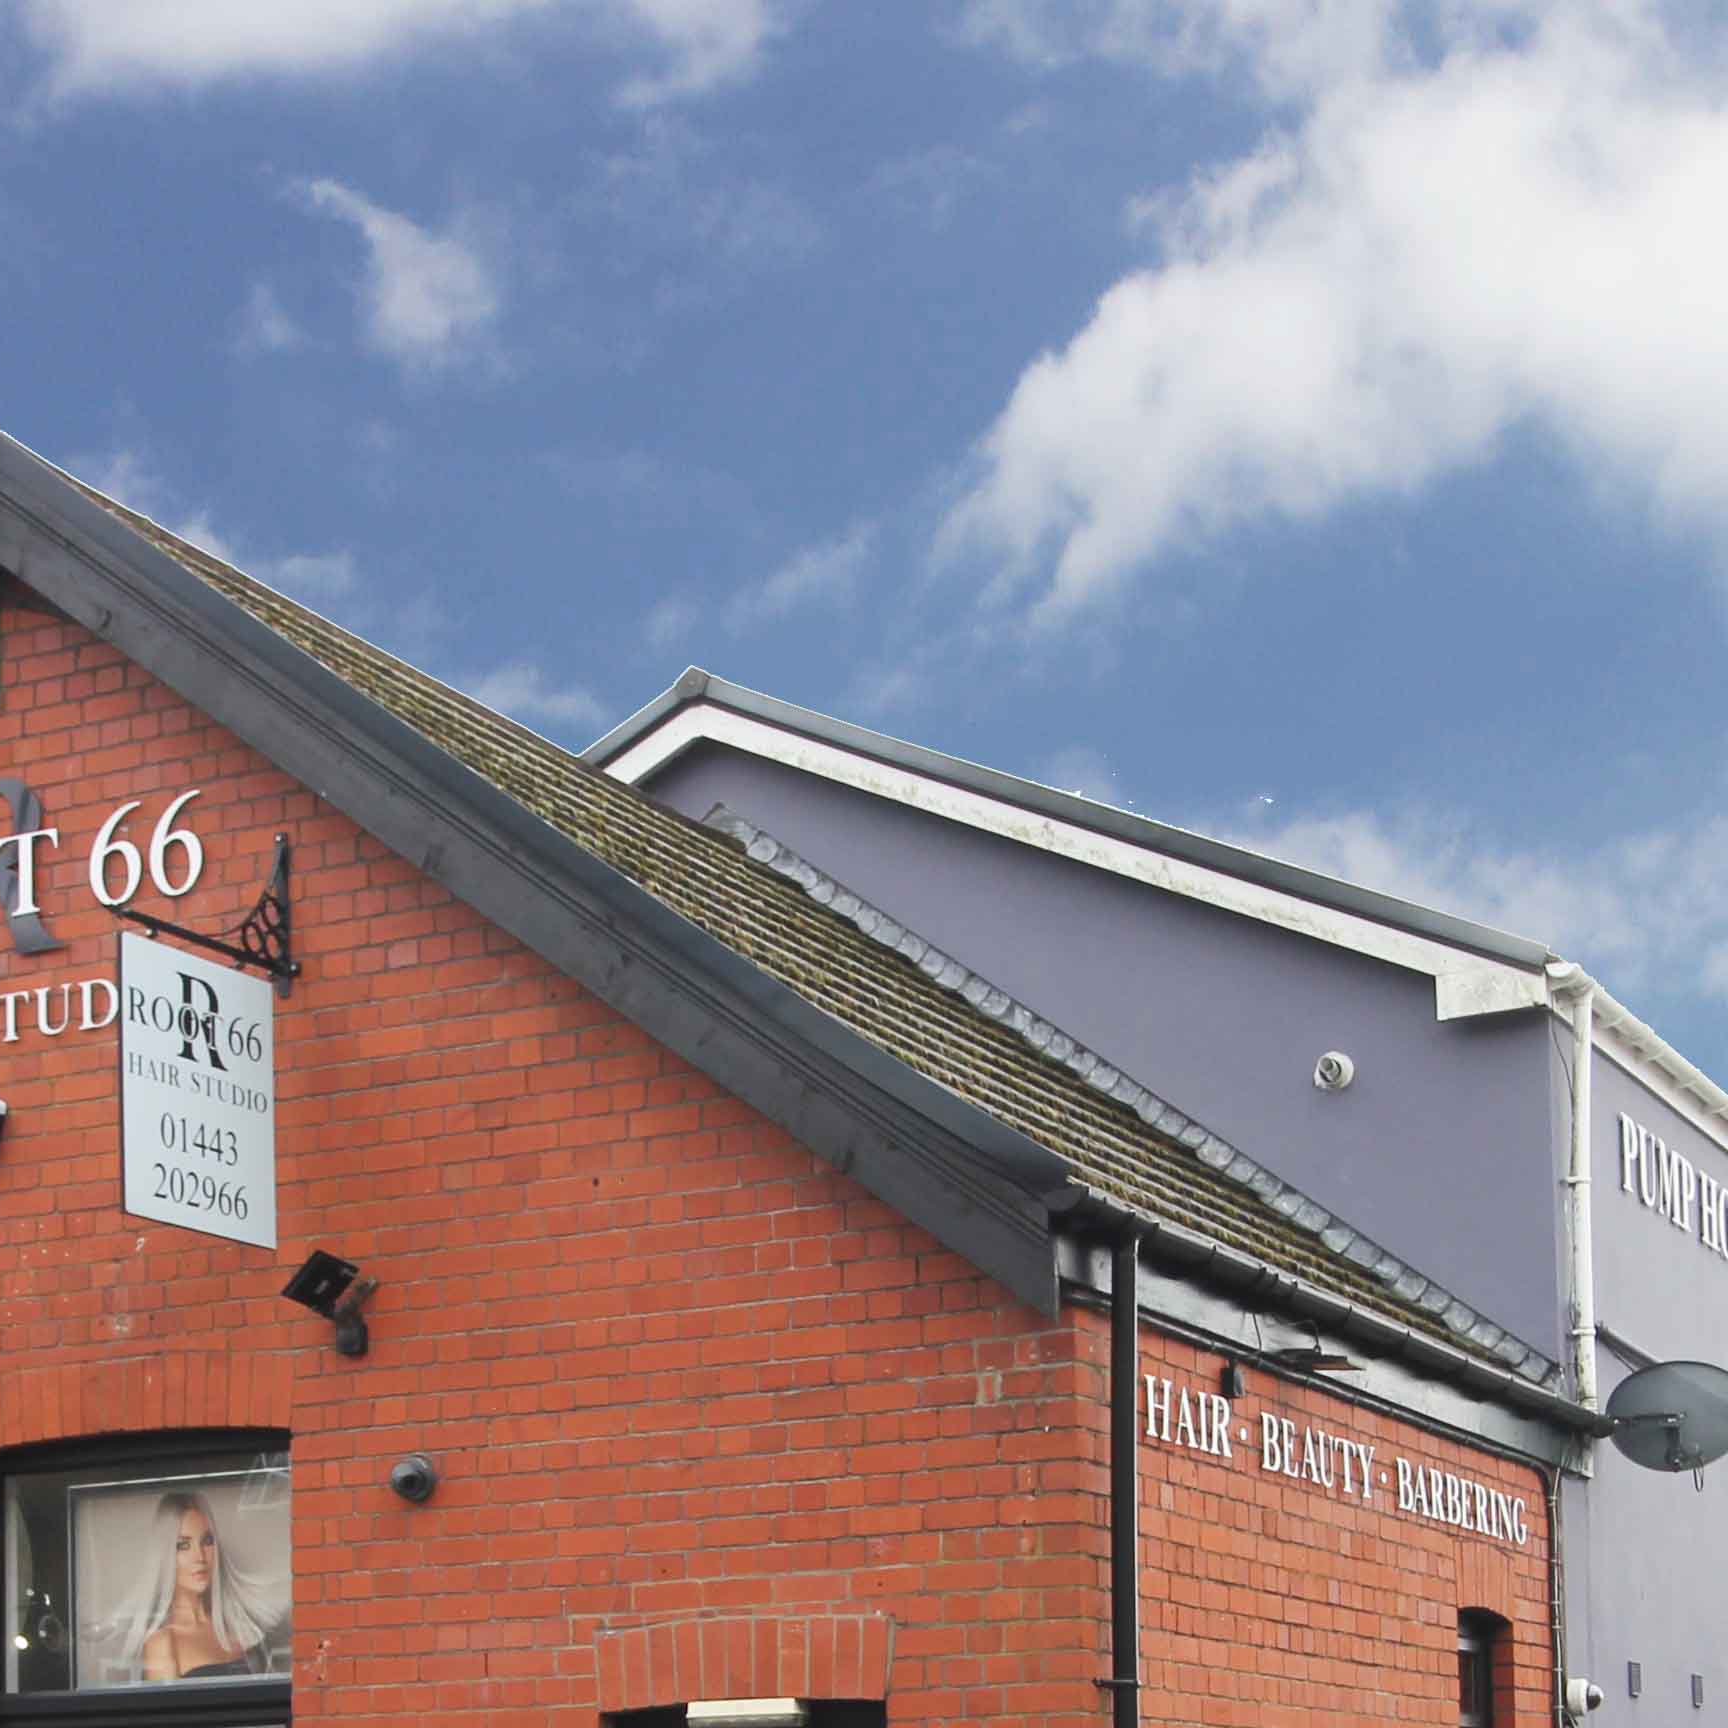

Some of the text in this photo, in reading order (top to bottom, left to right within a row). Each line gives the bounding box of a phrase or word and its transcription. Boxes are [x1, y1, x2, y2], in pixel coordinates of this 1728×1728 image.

[89, 789, 204, 906] 66
[128, 986, 263, 1063] ROOT 66
[128, 1051, 268, 1115] HAIR STUDIO
[159, 1111, 238, 1167] 01443
[1618, 1111, 1696, 1233] PUMP
[152, 1161, 249, 1220] 202966
[1144, 1374, 1528, 1545] HAIR BEAUTY BARBERING
